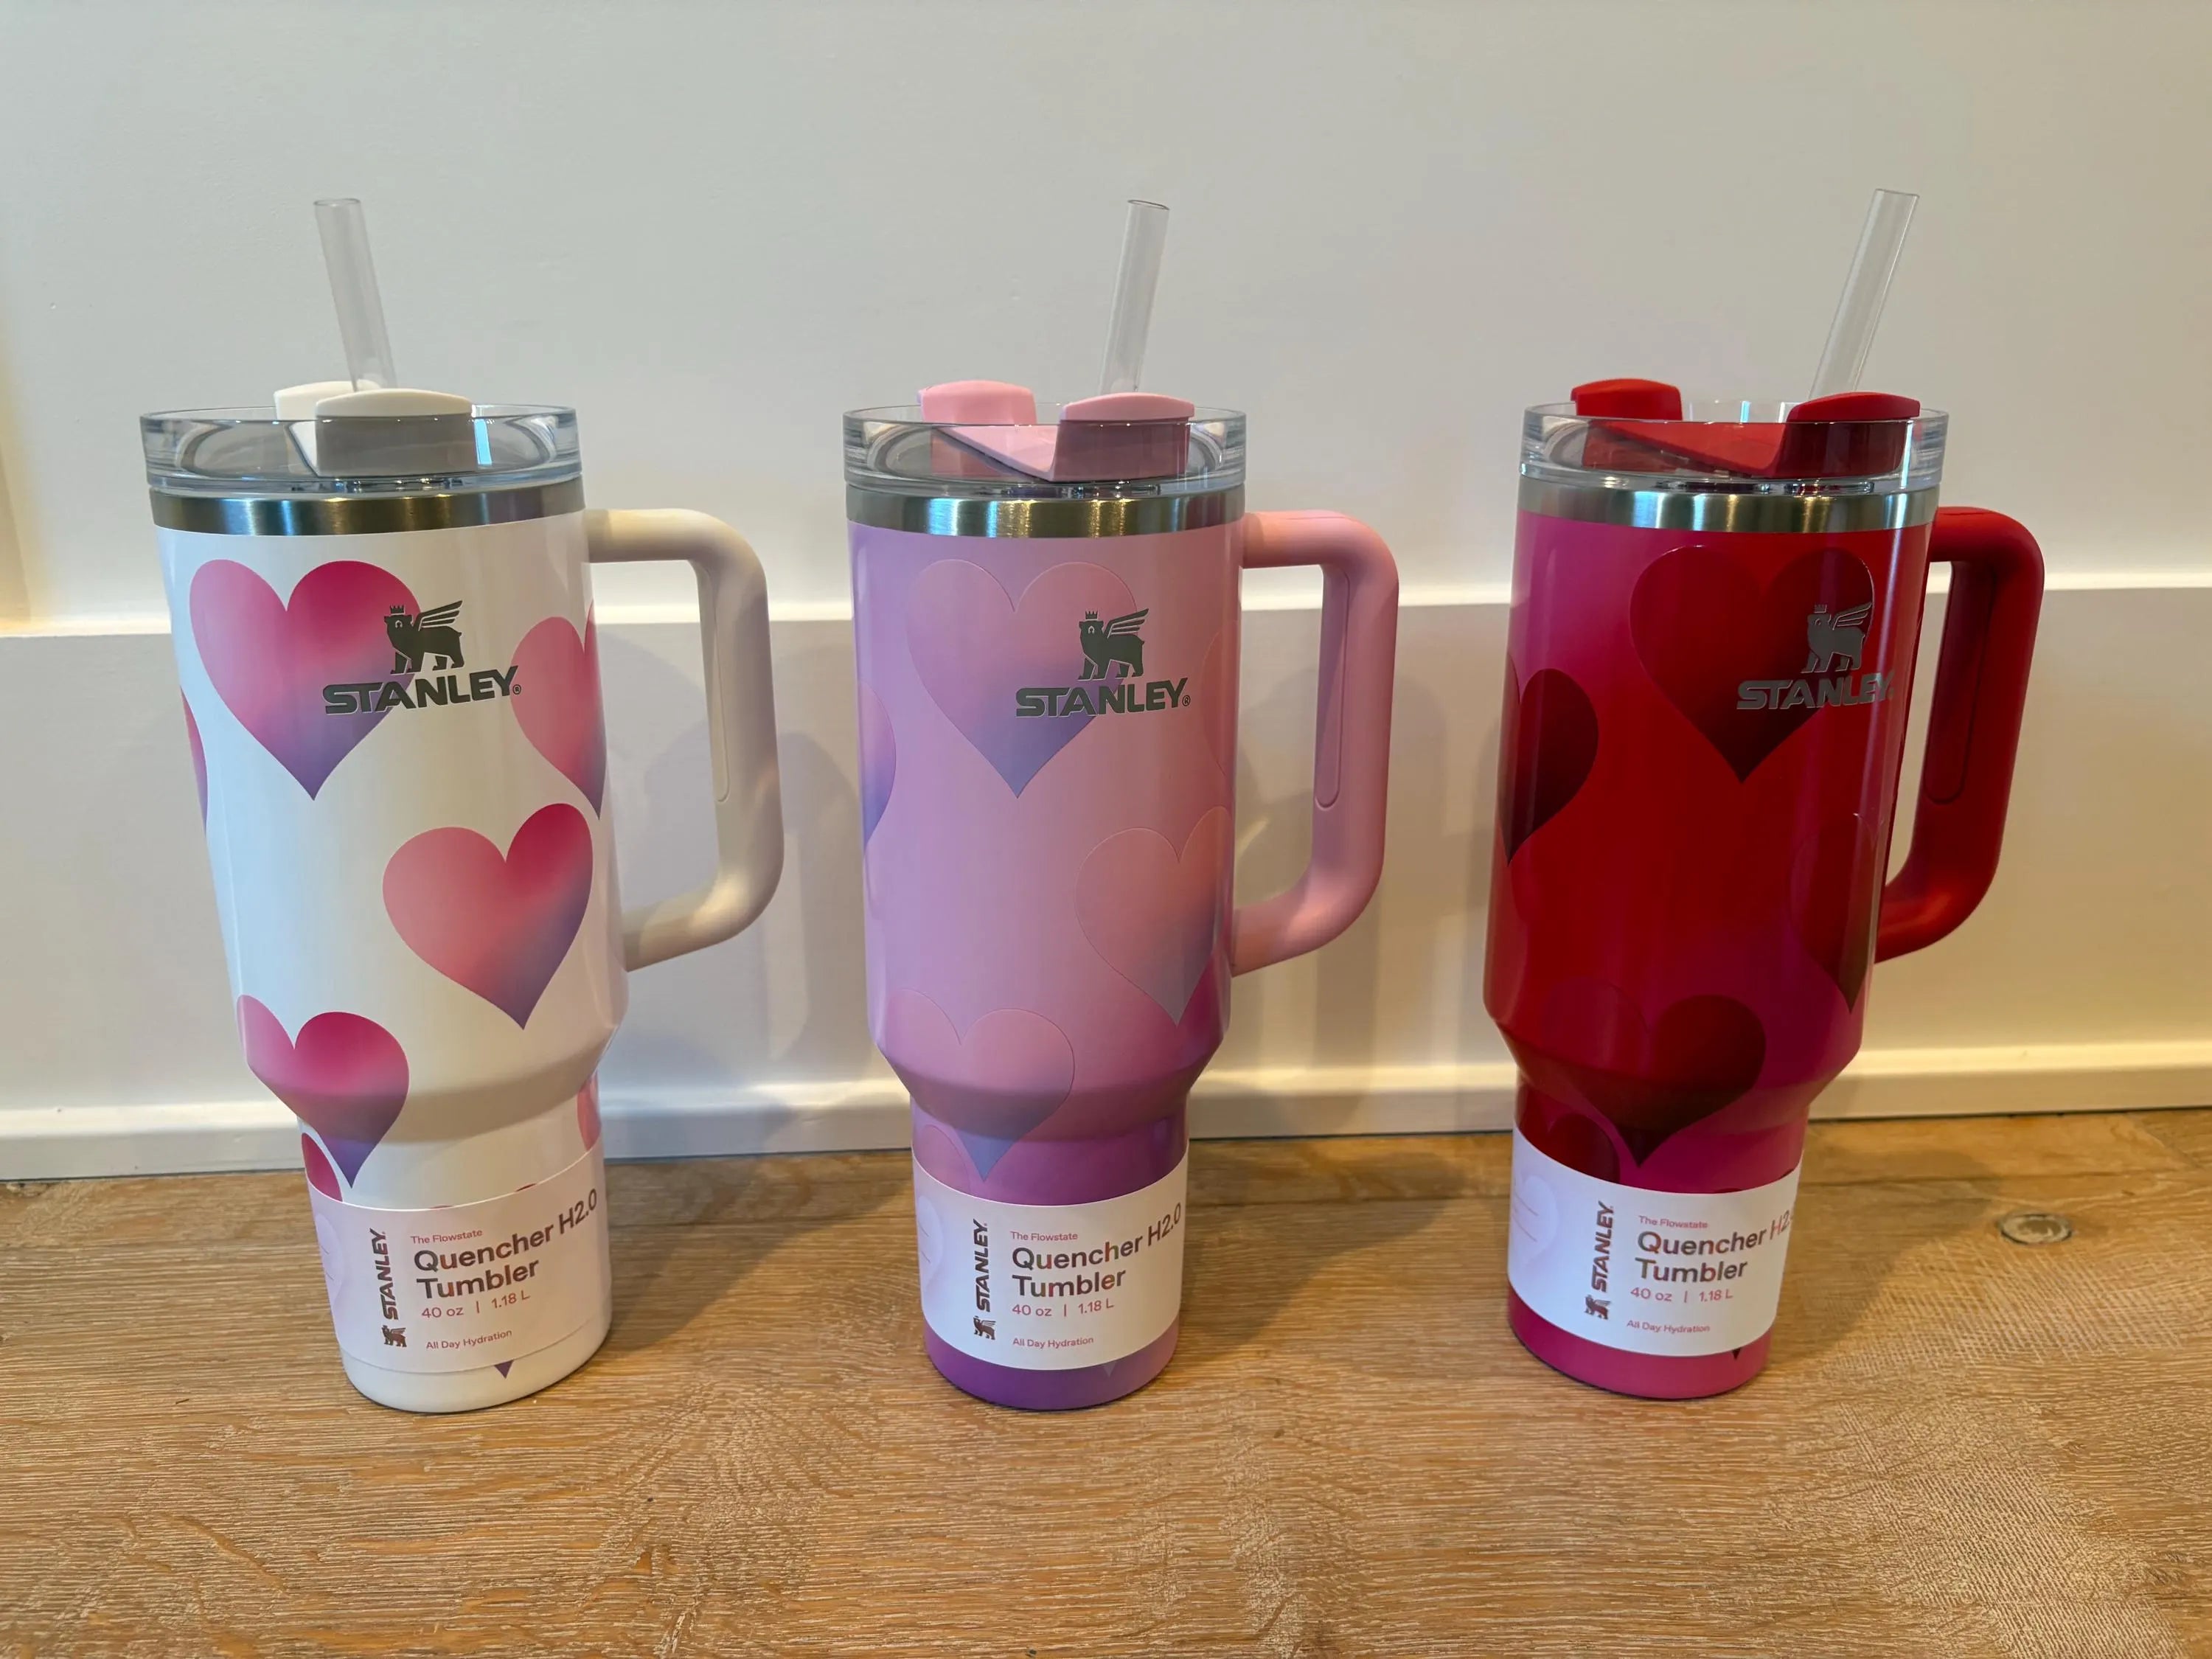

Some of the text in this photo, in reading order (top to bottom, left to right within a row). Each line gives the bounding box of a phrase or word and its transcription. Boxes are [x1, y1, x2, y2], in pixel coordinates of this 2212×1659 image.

[414, 1188, 598, 1273] Quencher H2.0
[1638, 1215, 1709, 1229] The Flowstate
[411, 1229, 483, 1245] The Flowstate
[1010, 1231, 1078, 1242] The Flowstate
[1012, 1201, 1181, 1271] Quencher H2.0
[1637, 1228, 1767, 1256] Quencher
[416, 1259, 539, 1299] Tumbler
[1635, 1257, 1747, 1283] Tumbler
[1012, 1270, 1126, 1298] Tumbler
[422, 1307, 442, 1319] 40
[446, 1306, 464, 1317] oz
[491, 1293, 517, 1310] 1.18
[521, 1290, 531, 1301] L
[1630, 1287, 1651, 1300] 40
[1655, 1291, 1672, 1302] oz
[1698, 1289, 1722, 1303] 1.18
[1725, 1288, 1733, 1300] L
[1012, 1304, 1032, 1316] 40
[1035, 1307, 1052, 1317] oz
[1078, 1299, 1102, 1315] 1.18
[1105, 1298, 1114, 1309] L
[1627, 1318, 1710, 1334] All Day Hydration
[426, 1329, 512, 1350] All Day Hydration
[1012, 1335, 1093, 1349] All Day Hydration
